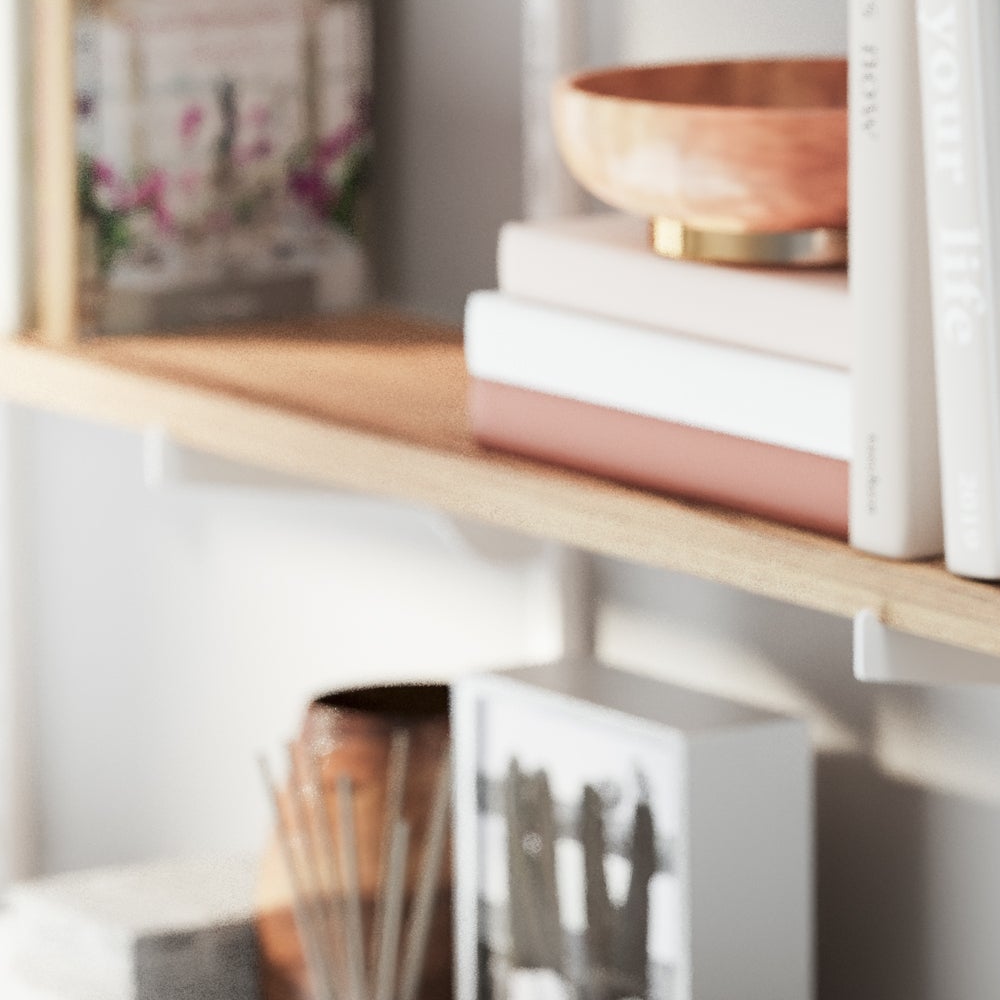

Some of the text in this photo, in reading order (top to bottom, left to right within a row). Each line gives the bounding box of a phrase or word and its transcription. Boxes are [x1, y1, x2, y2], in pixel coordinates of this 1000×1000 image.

[860, 43, 883, 143] now
[917, 2, 968, 186] your
[939, 225, 986, 351] life
